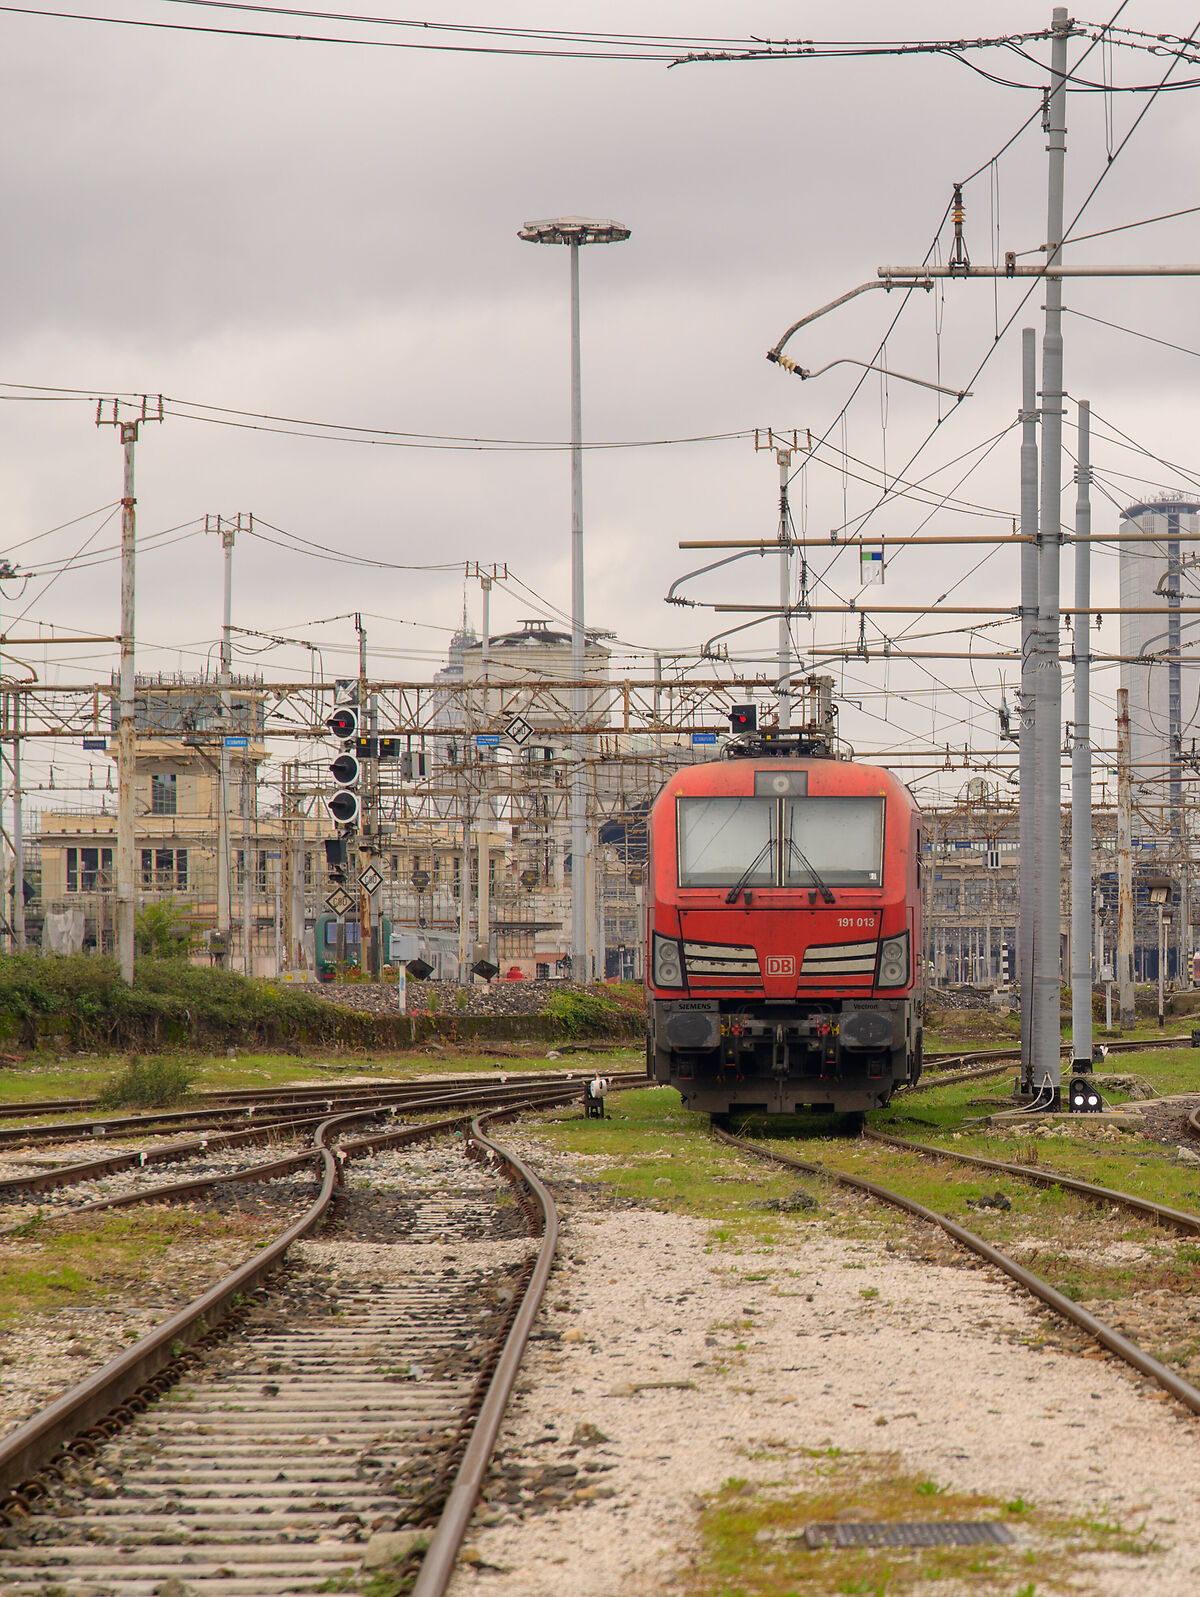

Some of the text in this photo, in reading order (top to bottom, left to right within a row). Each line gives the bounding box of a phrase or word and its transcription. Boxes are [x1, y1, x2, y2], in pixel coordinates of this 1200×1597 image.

[837, 917, 875, 927] 191 013
[769, 959, 792, 973] DB
